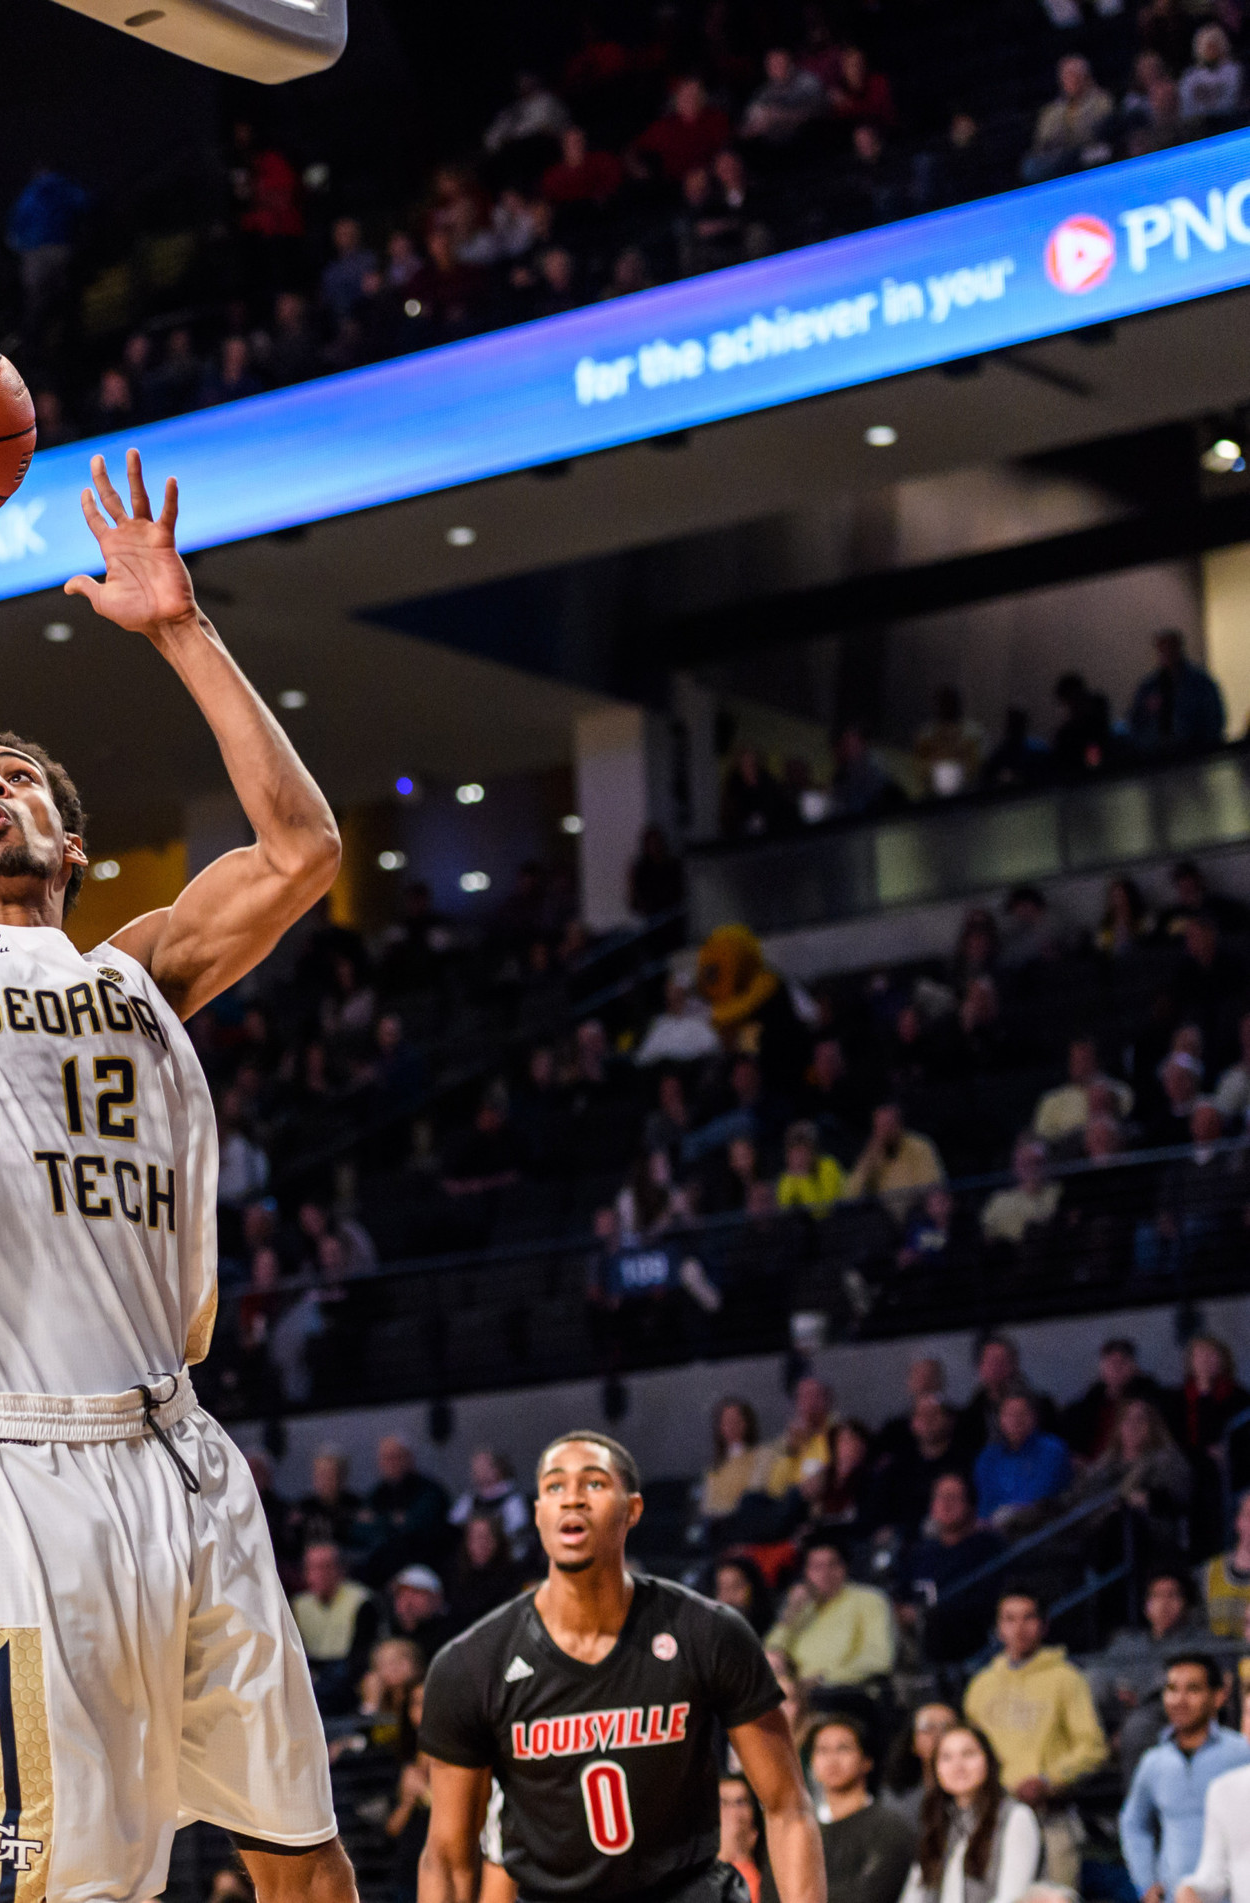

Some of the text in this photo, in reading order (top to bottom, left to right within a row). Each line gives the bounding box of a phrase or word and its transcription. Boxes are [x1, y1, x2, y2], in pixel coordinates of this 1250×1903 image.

[575, 262, 1007, 406] for the achiever in your
[61, 1055, 137, 1142] 12
[34, 1150, 178, 1234] TECH
[511, 1702, 690, 1760] LOUISVILLE
[580, 1759, 635, 1856] 0
